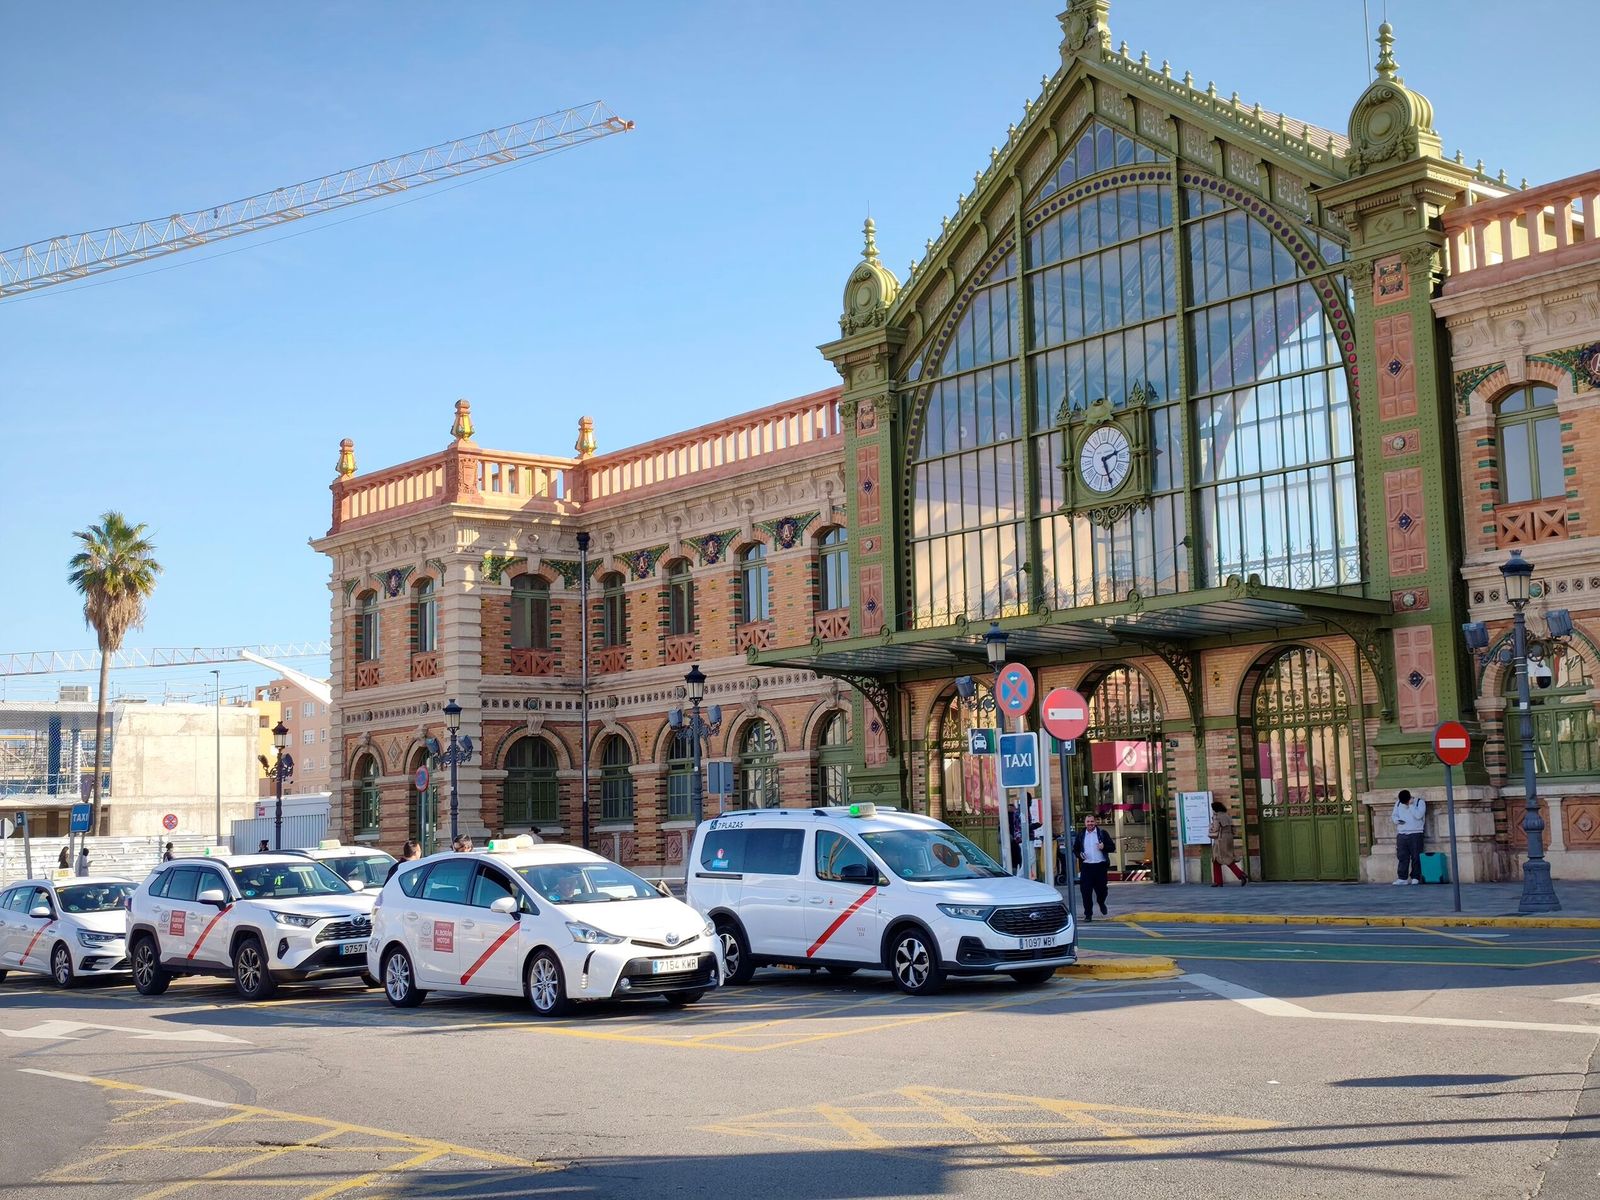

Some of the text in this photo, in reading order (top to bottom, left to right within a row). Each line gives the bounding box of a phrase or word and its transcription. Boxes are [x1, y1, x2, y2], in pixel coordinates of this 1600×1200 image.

[1003, 752, 1033, 768] TAXI
[73, 813, 89, 822] TAXI
[722, 821, 744, 829] PLAZAS
[1024, 937, 1041, 948] 1097
[344, 944, 363, 953] 9757
[660, 958, 697, 971] 7154 KWR
